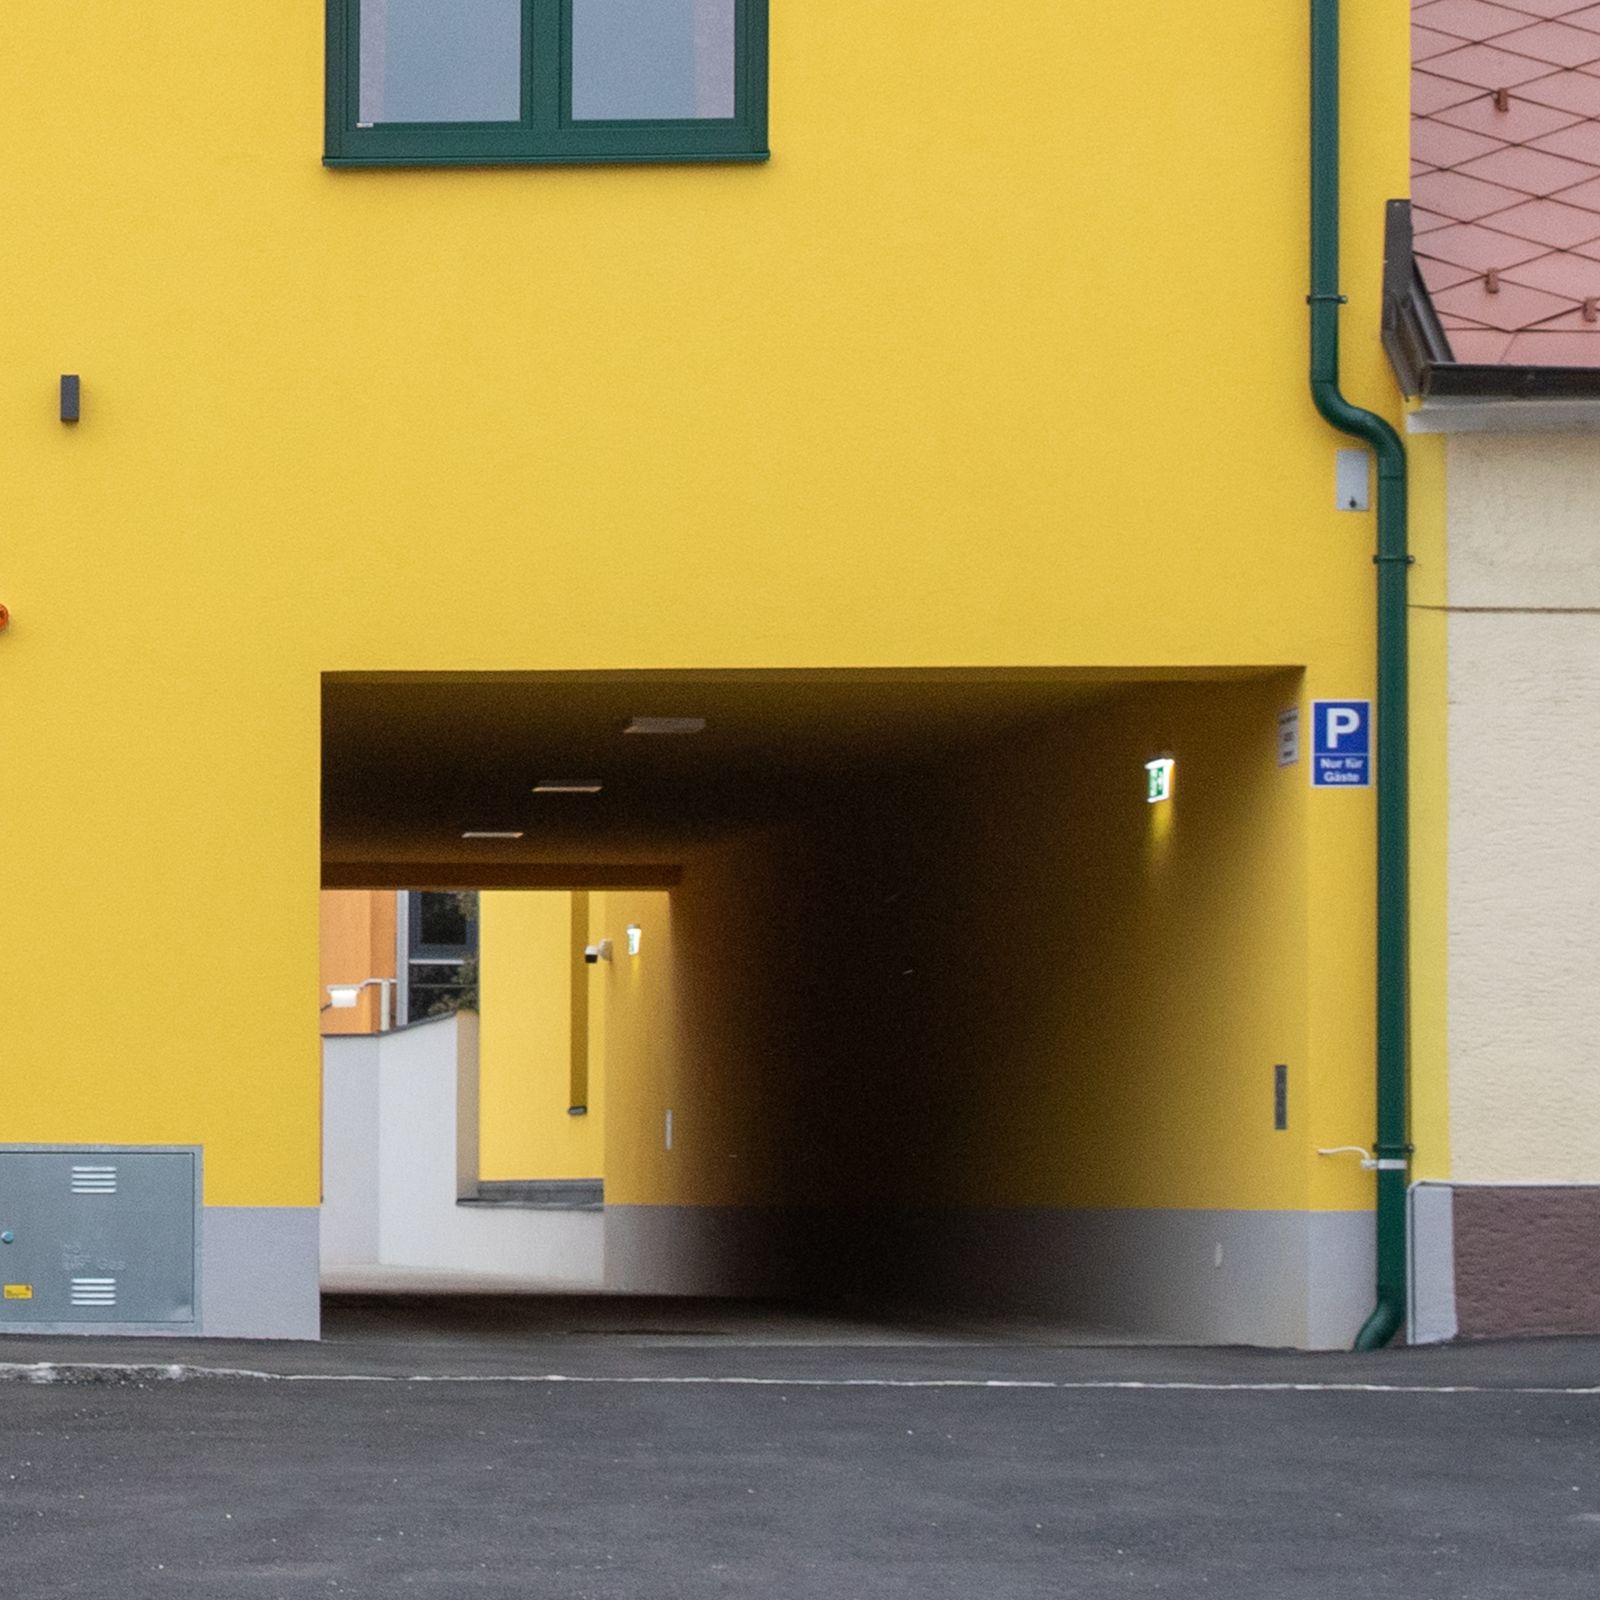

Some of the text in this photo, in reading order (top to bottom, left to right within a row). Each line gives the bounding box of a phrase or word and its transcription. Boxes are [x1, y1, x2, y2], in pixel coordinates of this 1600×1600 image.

[1326, 707, 1360, 749] P
[1320, 757, 1364, 769] Nur für
[1323, 770, 1361, 783] Gäste
